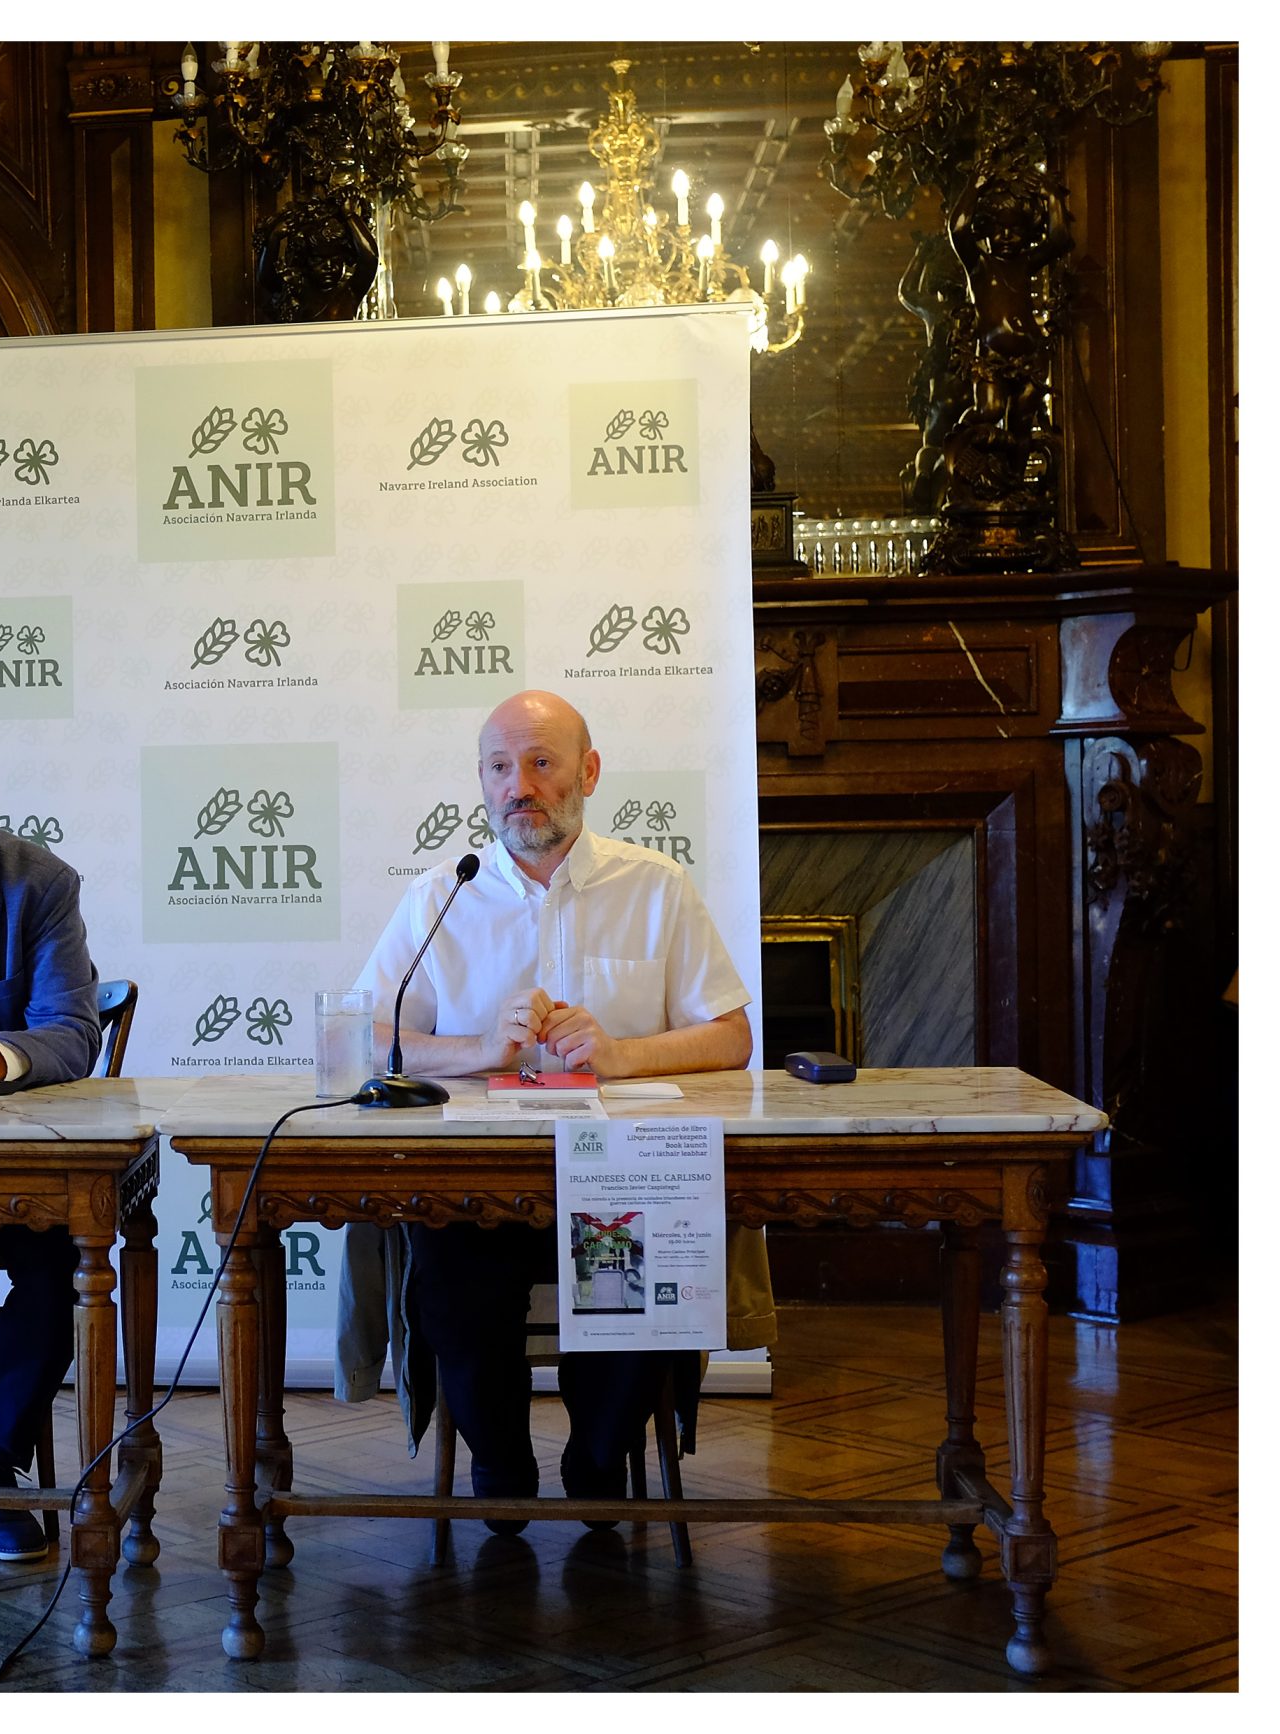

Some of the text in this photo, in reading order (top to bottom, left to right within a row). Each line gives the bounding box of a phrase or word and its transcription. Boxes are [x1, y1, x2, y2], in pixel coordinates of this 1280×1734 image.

[586, 444, 688, 476] ANIR
[162, 461, 317, 510] ANIR
[379, 475, 538, 492] Navarre Ireland Association
[34, 494, 80, 506] Elkartea
[163, 509, 317, 525] Asociación Navarra Irlanda
[414, 645, 514, 676] ANIR
[564, 664, 713, 679] Nafarroa Irlanda Elkartea
[164, 676, 318, 691] Asociación Navarra Irlanda
[167, 844, 322, 891] ANIR
[168, 893, 322, 905] Asociación Navarra Irlanda
[171, 1056, 314, 1067] Nafarroa Irlanda Elkartea
[573, 1142, 604, 1152] ANIR
[569, 1173, 712, 1184] IRLANDESES CON EL CARLISMO
[171, 1231, 326, 1276] AR
